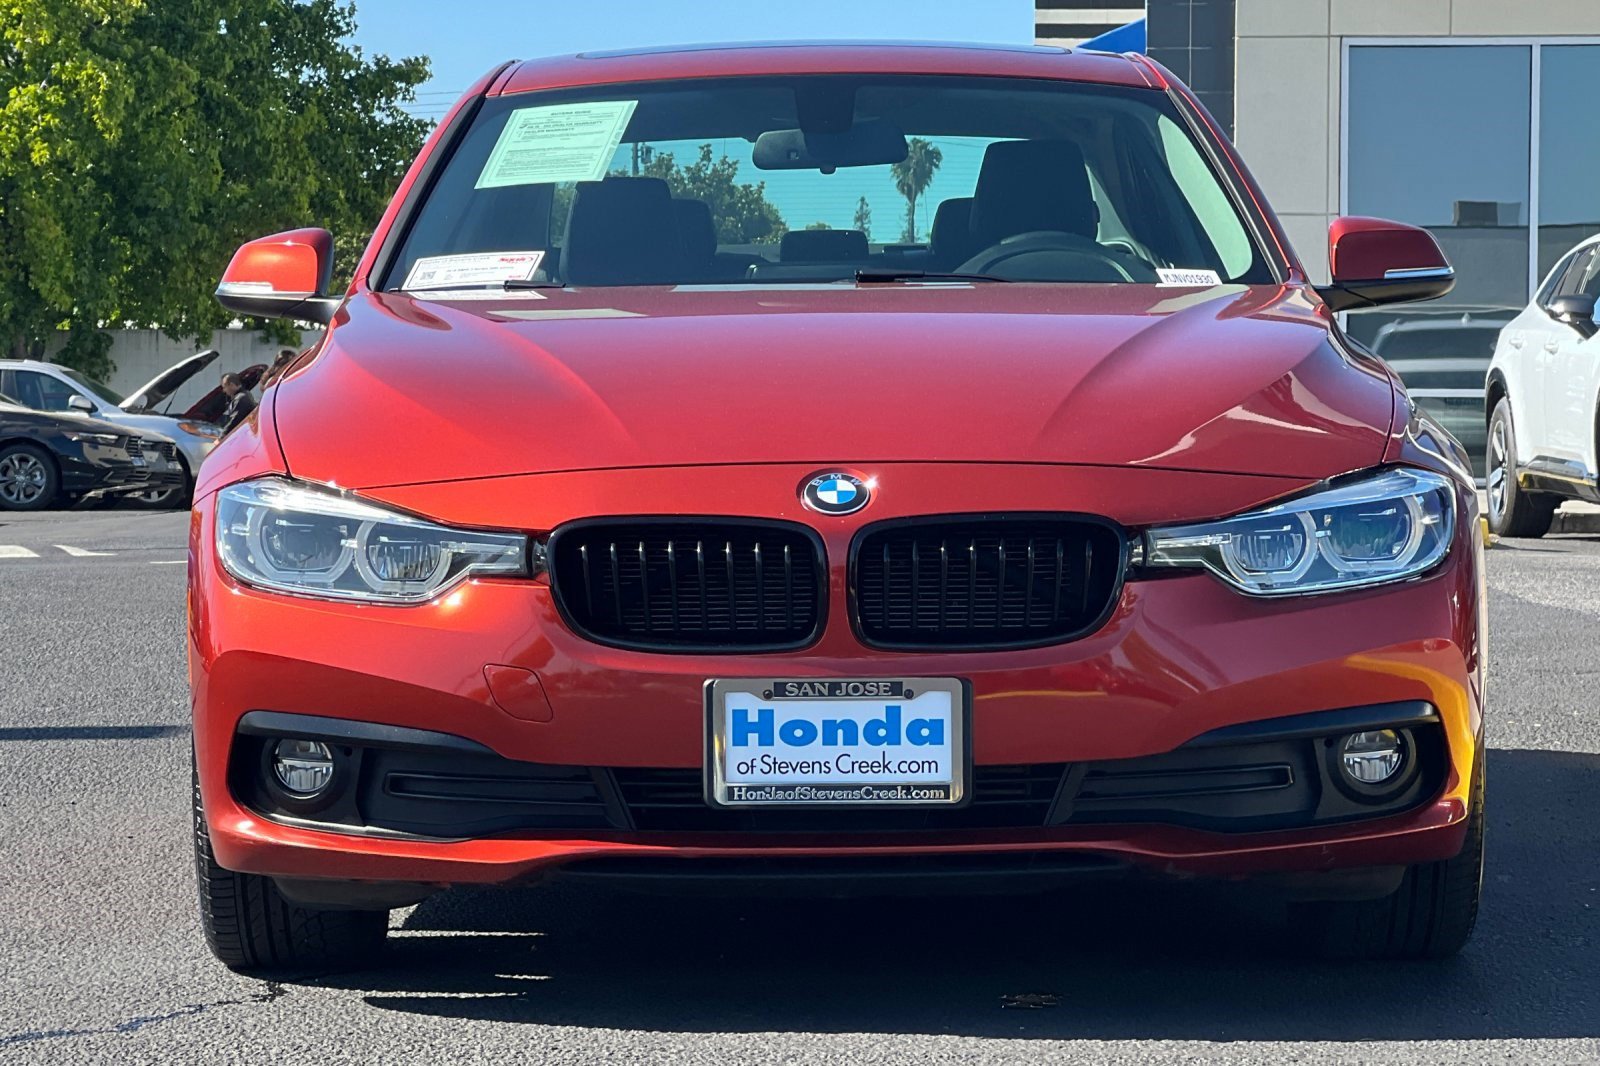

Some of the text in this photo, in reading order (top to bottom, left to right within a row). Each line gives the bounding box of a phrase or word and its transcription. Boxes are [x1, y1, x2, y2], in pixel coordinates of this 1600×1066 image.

[811, 474, 861, 486] BMW
[785, 682, 892, 696] SAN JOSE
[732, 705, 945, 747] Honda
[736, 751, 939, 775] of Stevens Creek.com
